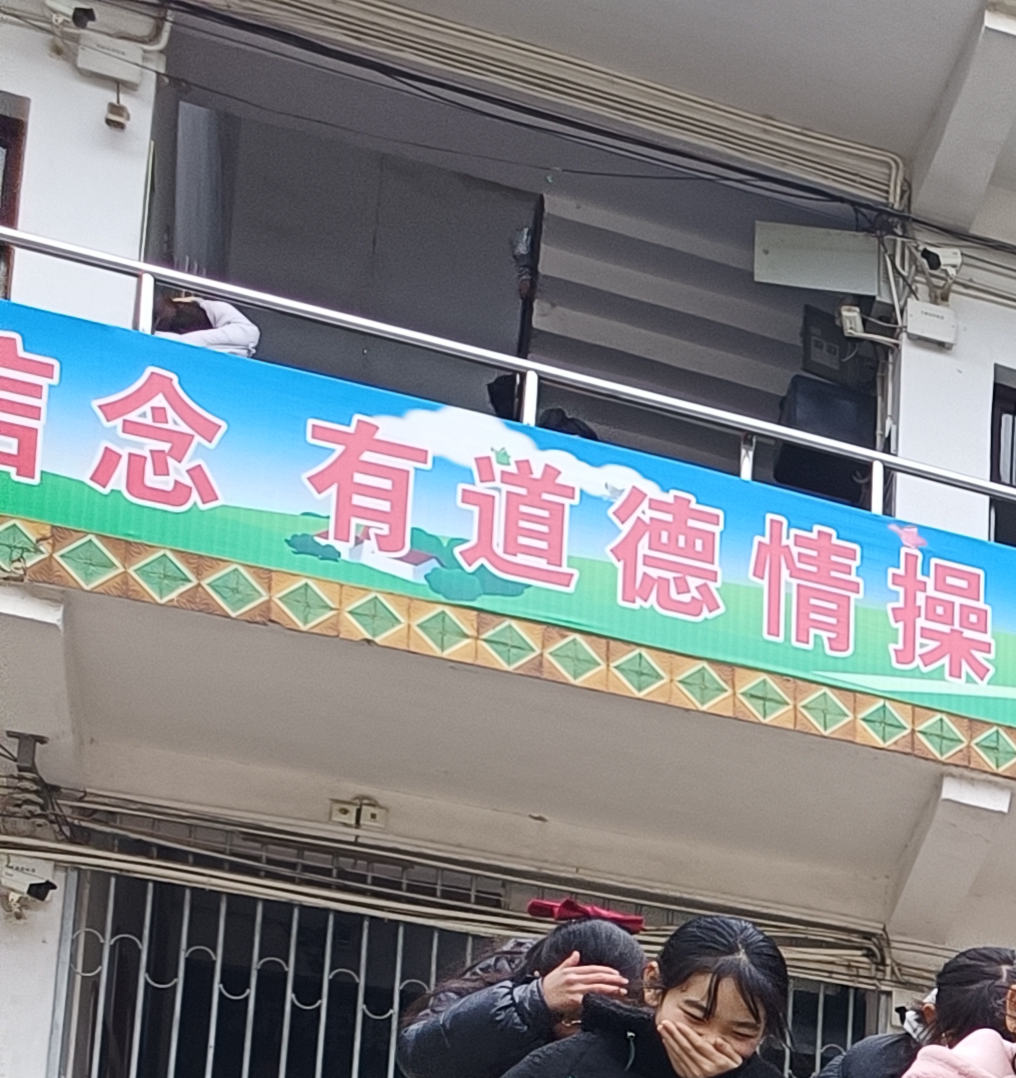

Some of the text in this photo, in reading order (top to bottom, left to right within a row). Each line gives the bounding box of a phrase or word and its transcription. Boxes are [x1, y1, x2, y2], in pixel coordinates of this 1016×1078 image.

[304, 416, 994, 683] 有道德情操
